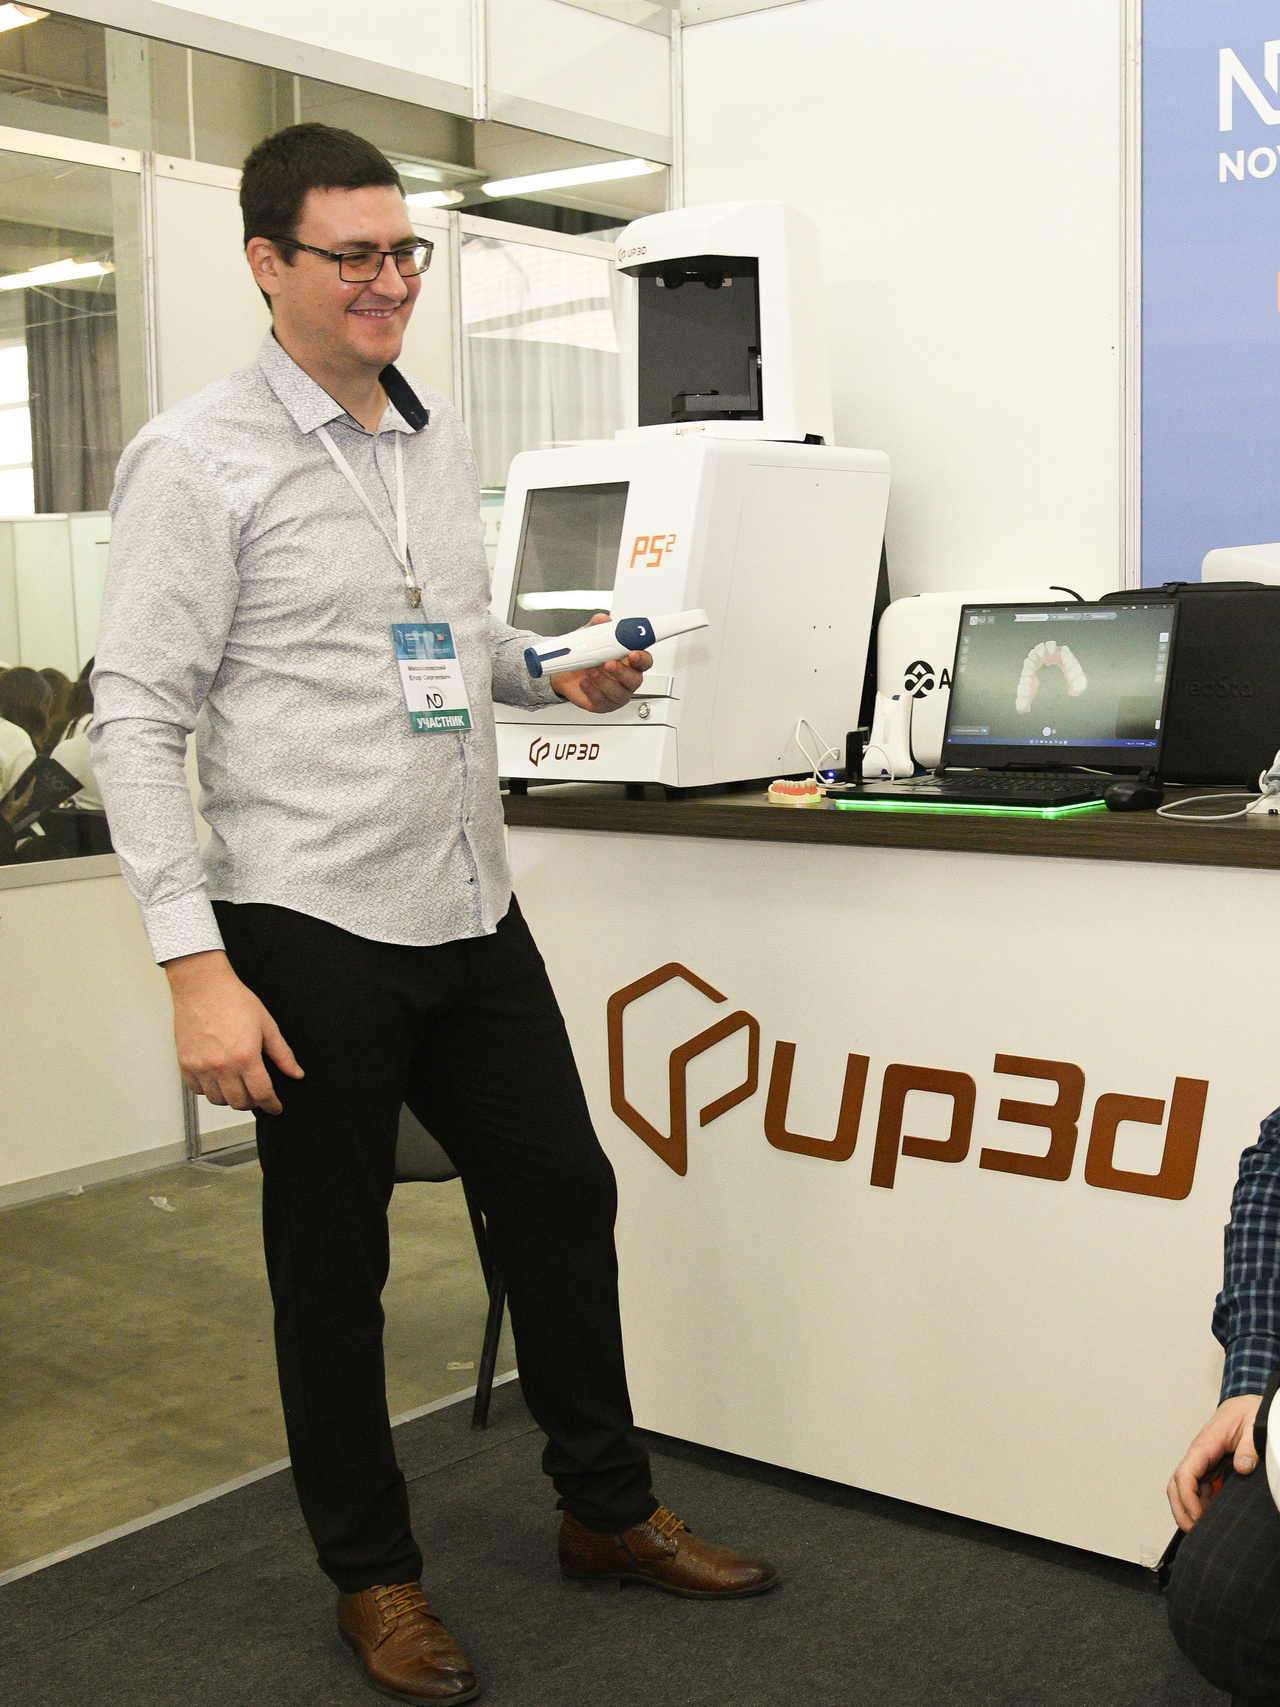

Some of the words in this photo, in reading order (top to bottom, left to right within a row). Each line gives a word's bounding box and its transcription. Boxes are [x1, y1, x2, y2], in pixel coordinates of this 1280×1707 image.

[416, 715, 465, 729] УЧАСТНИК
[554, 743, 600, 761] UP3D
[763, 1040, 1210, 1201] up3d
